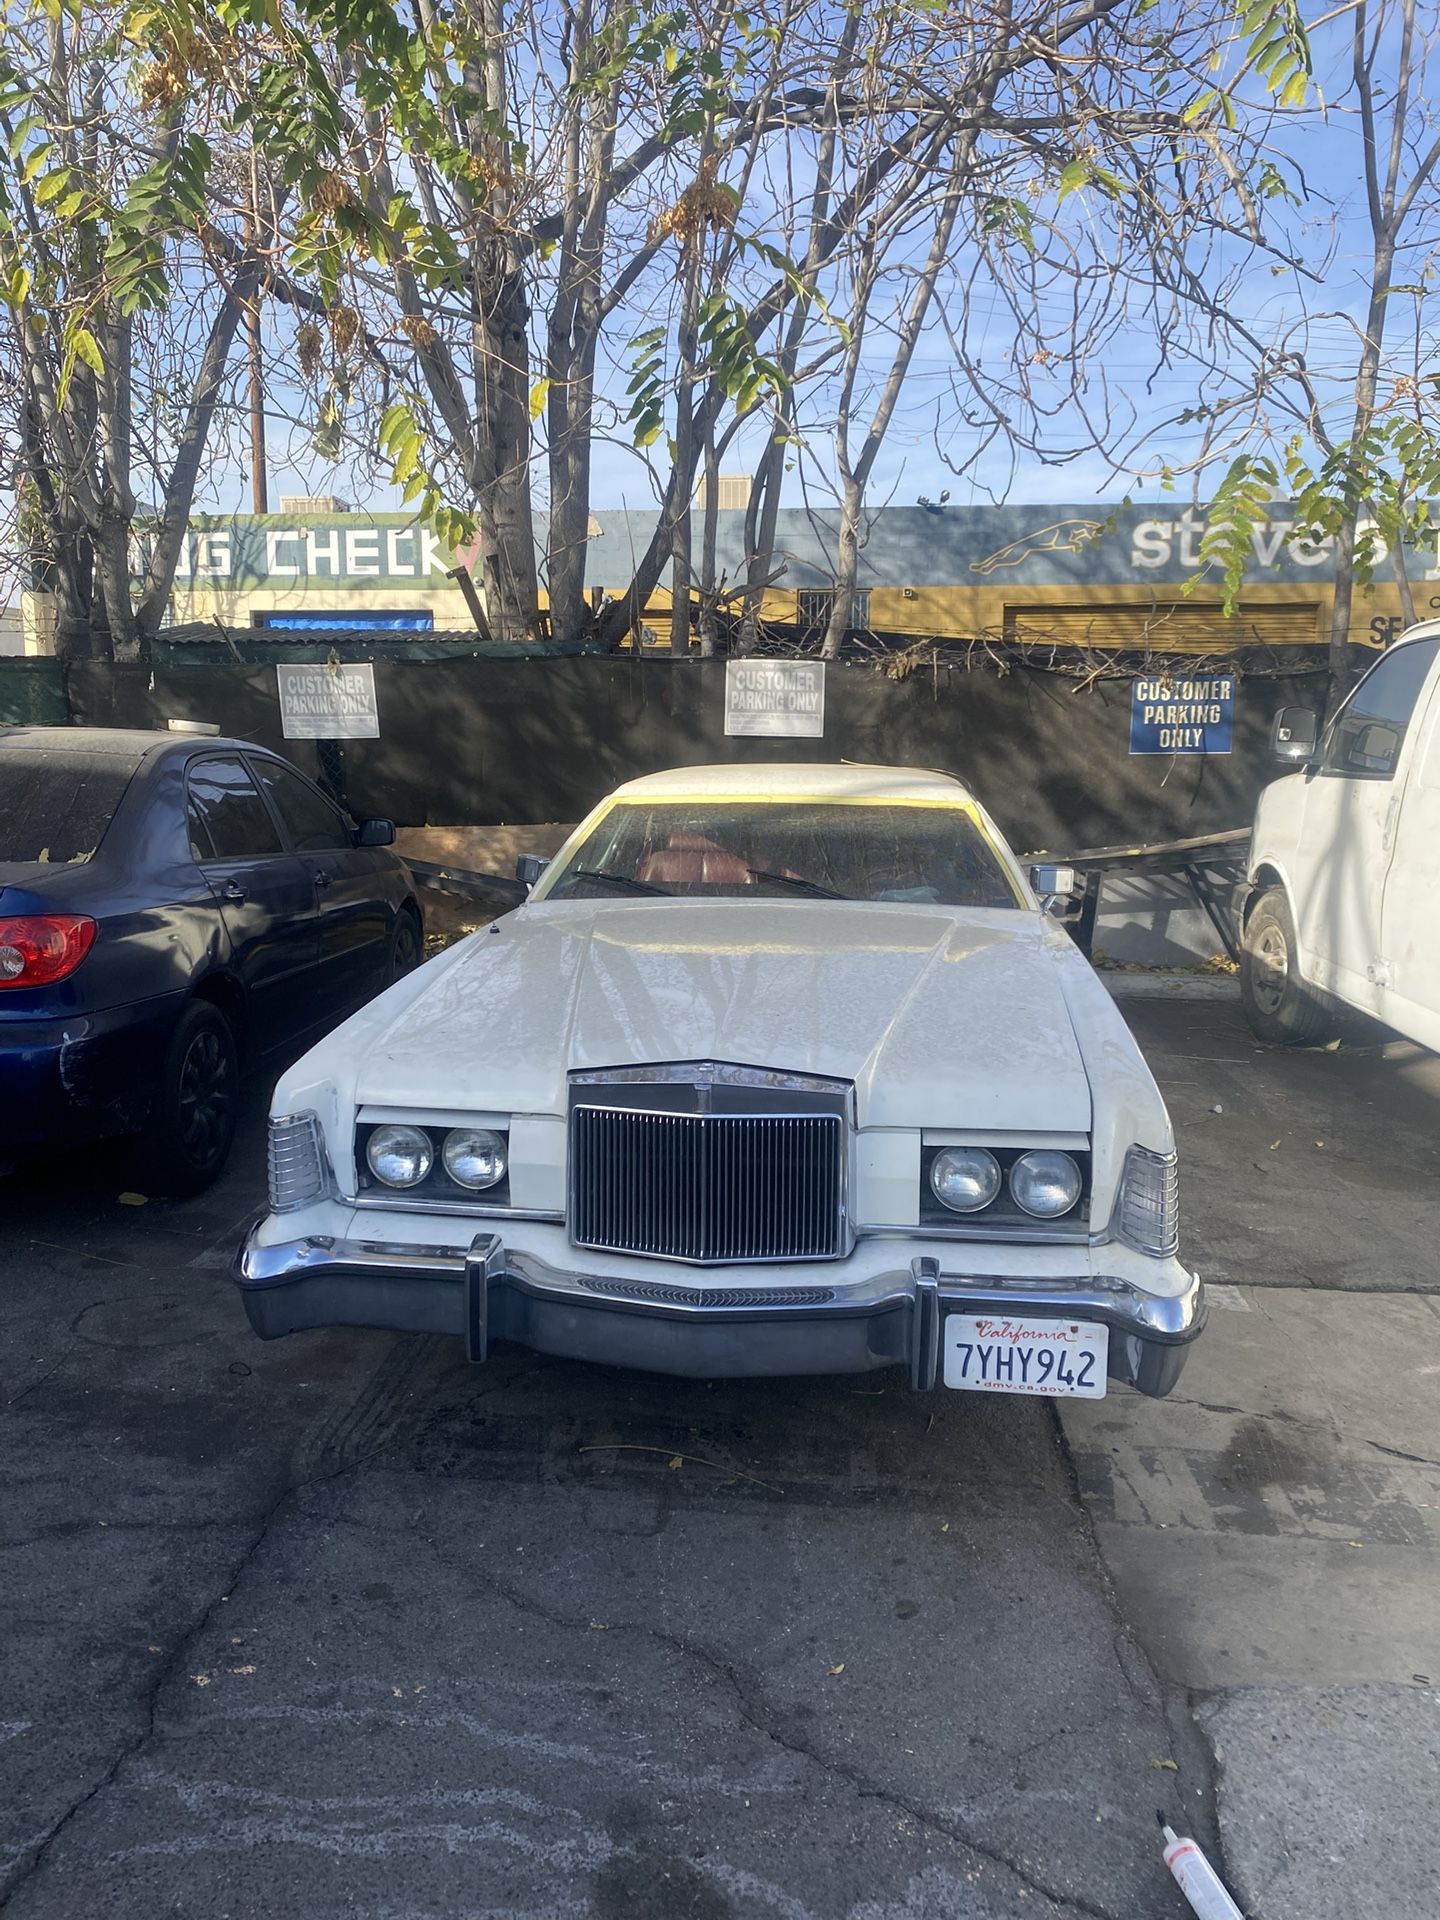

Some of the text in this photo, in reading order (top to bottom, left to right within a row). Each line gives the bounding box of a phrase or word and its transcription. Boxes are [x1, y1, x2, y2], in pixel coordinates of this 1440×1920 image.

[266, 529, 451, 576] CHECK
[287, 675, 365, 694] CUSTOMER
[736, 670, 815, 691] CUSTOMER
[1137, 680, 1231, 701] CUSTOMER
[285, 695, 370, 714] PARKING ONLY
[731, 690, 818, 711] PARKING ONLY
[1143, 704, 1221, 725] PARKING
[1160, 728, 1203, 748] ONLY
[978, 1319, 1077, 1345] California
[956, 1343, 1095, 1387] 7YHY942
[983, 1380, 1066, 1394] dmv.ca.gov
